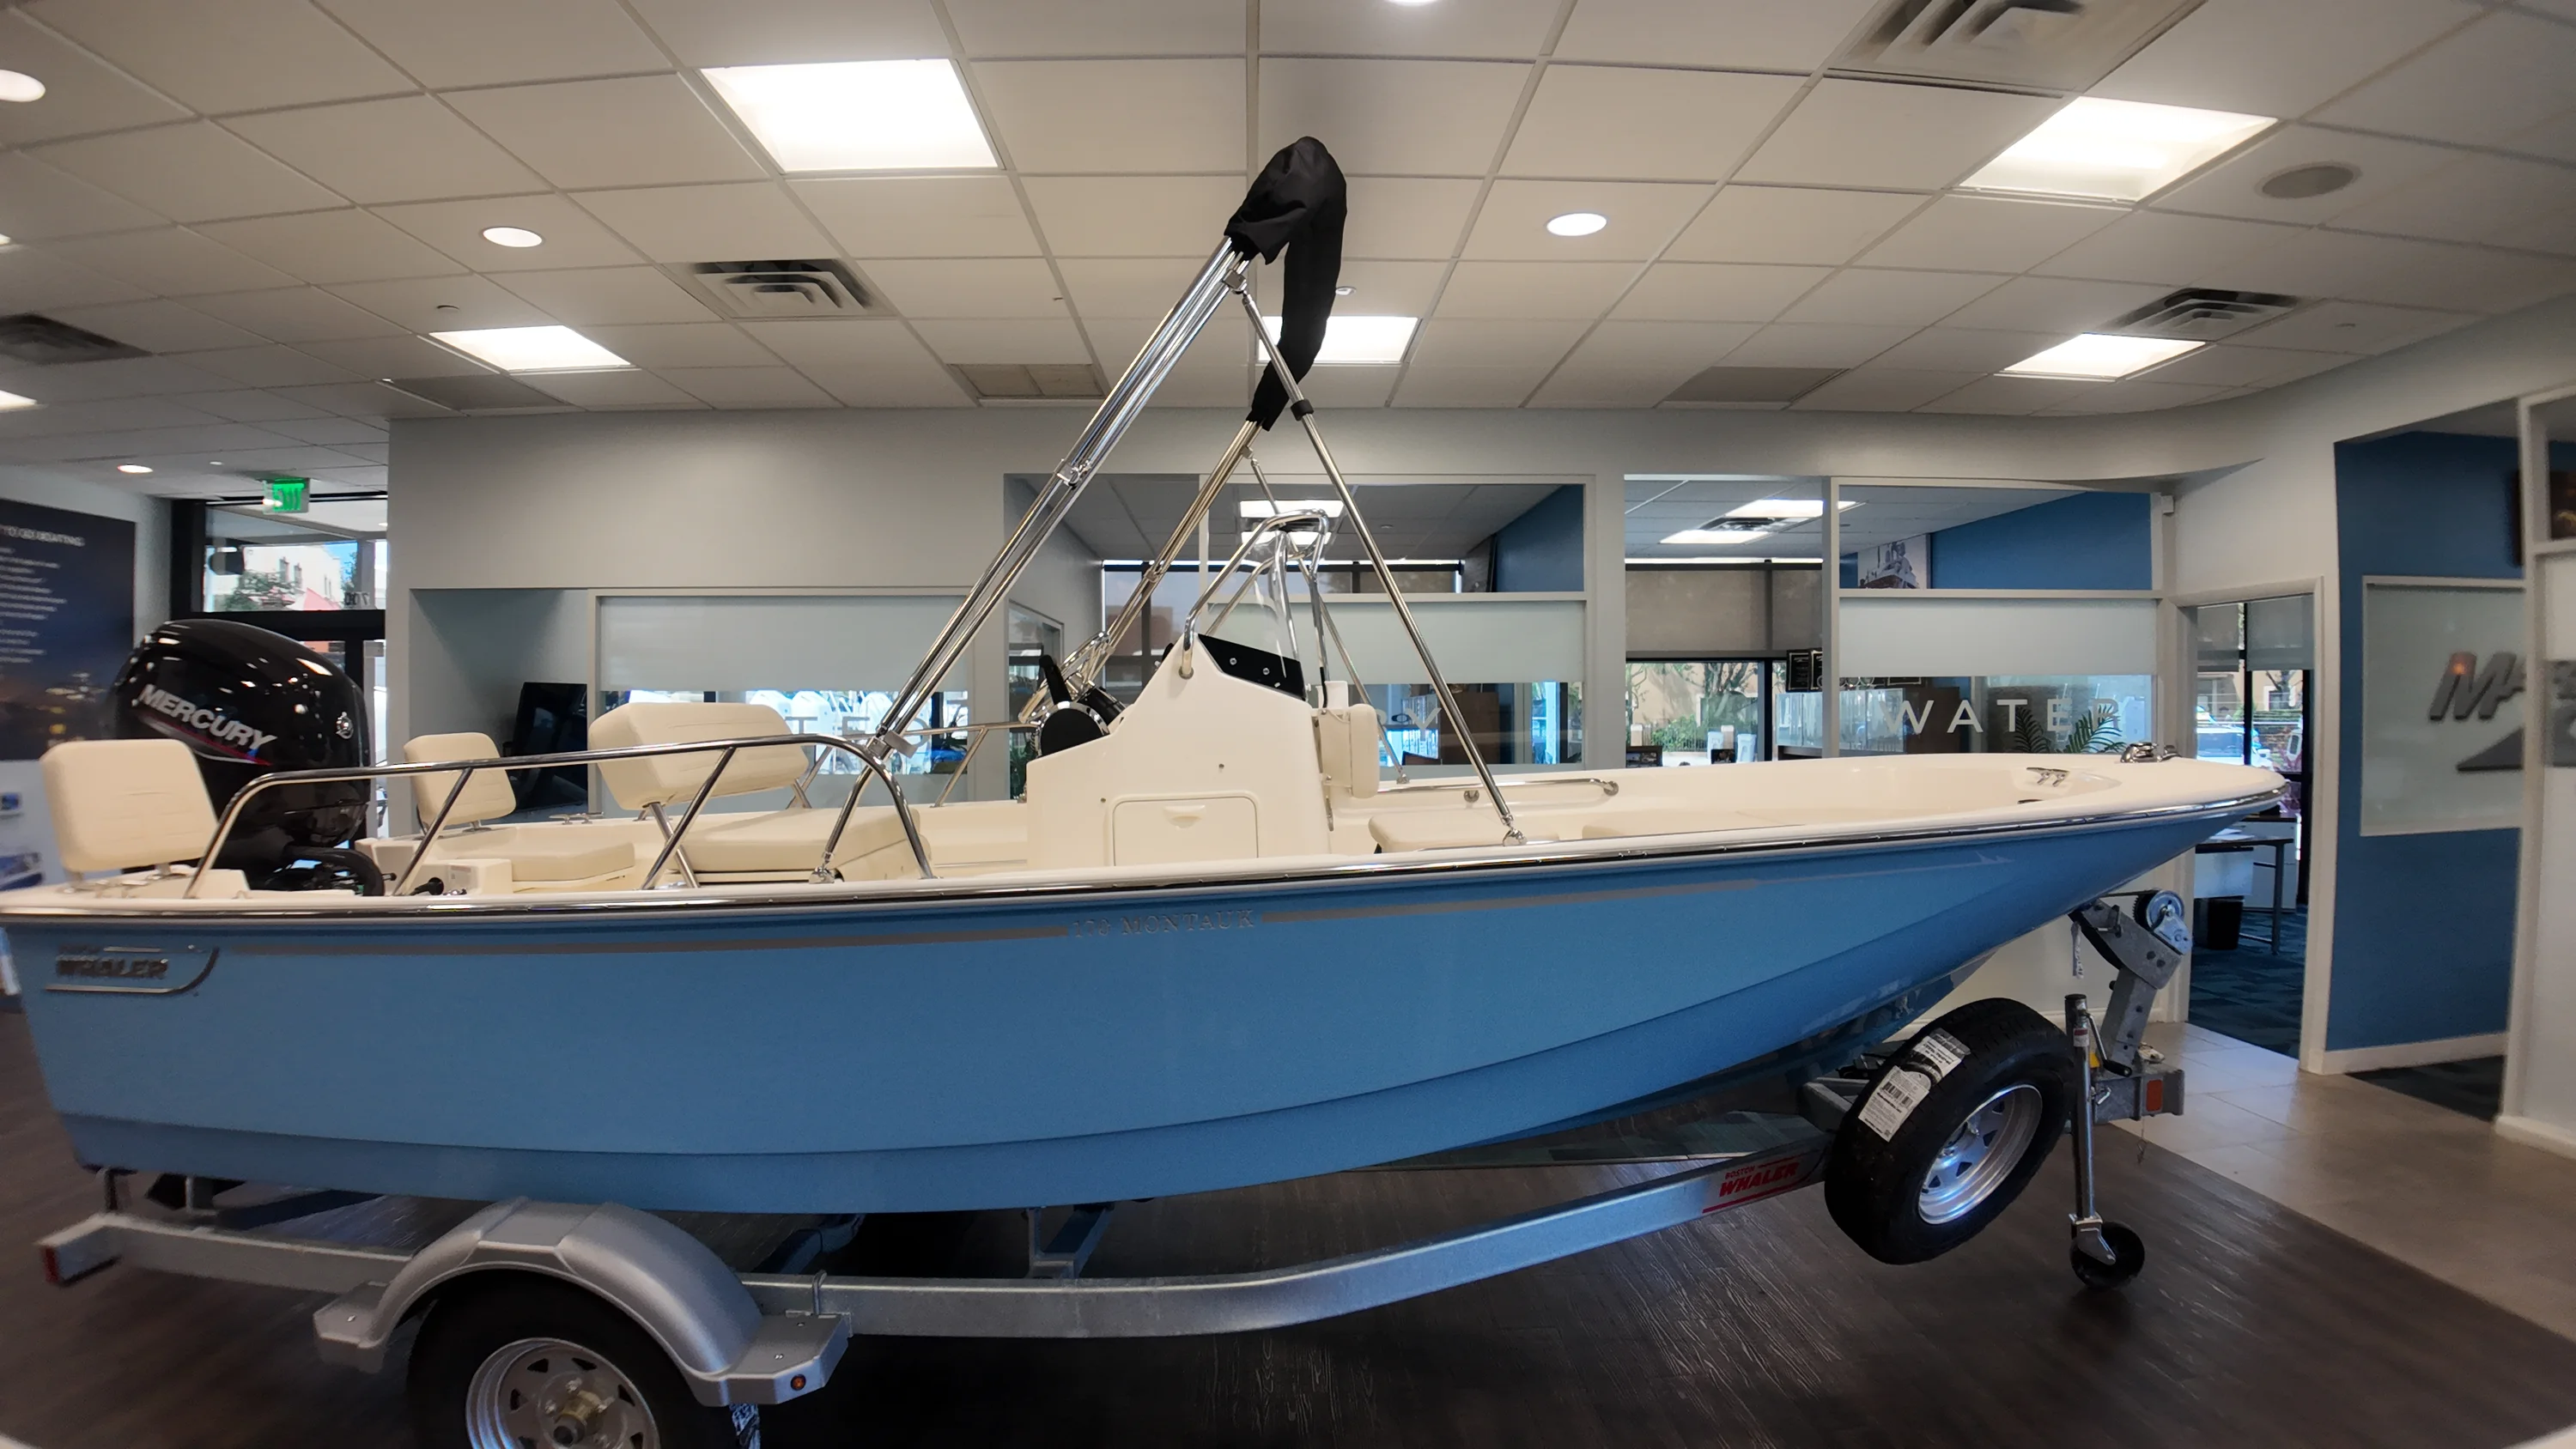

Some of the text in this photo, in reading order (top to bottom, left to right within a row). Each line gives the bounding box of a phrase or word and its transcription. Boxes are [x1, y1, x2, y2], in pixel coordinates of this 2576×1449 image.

[138, 684, 277, 749] MERCURY
[1880, 699, 2118, 733] WATER
[1121, 910, 1254, 935] MONTAUK
[1719, 1162, 1800, 1197] WHALER
